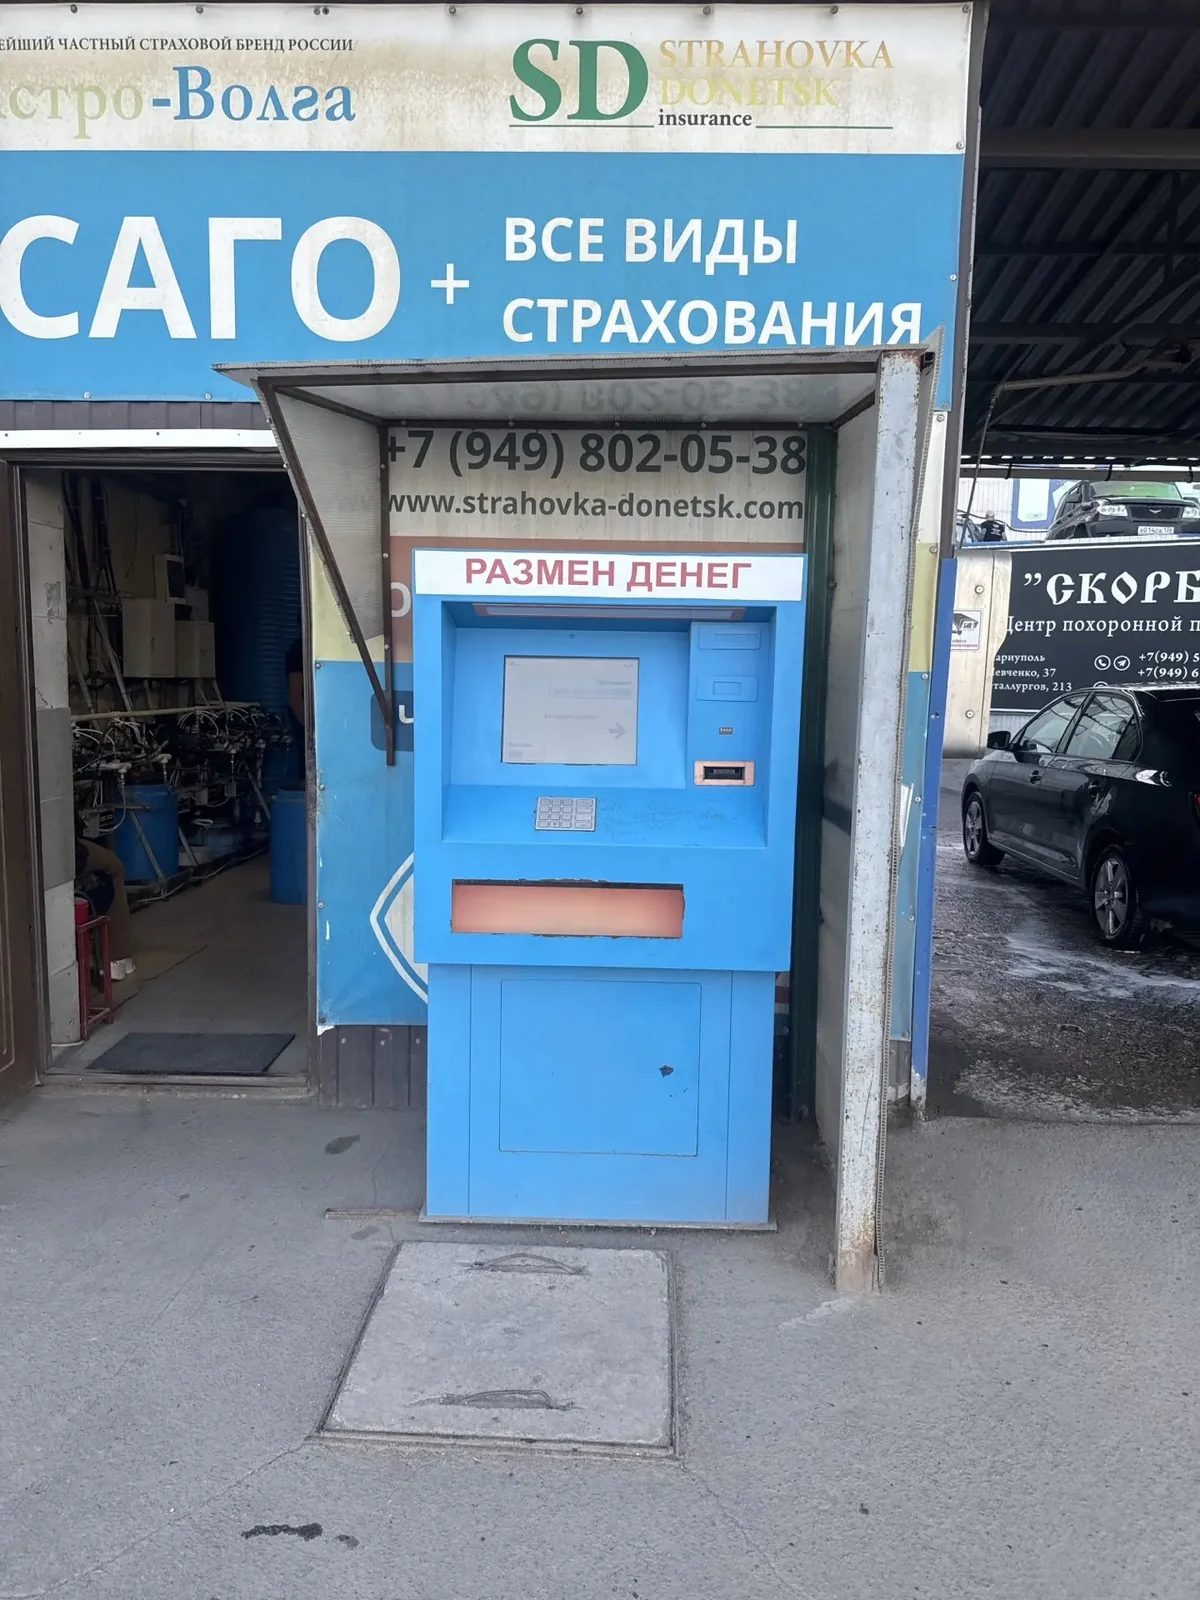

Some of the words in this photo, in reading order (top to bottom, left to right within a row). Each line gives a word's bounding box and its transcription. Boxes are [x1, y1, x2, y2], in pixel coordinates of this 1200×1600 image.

[0, 35, 55, 51] ЕЙШИЙ
[58, 35, 136, 52] ЧАСТНЫЙ
[139, 36, 233, 52] СТРАХОВОЙ
[235, 38, 285, 54] БРЕНД
[287, 38, 353, 52] РОССИИ
[659, 39, 895, 69] STRAHOVKA
[509, 38, 649, 122] SD
[660, 76, 838, 107] DONETSK
[0, 66, 356, 140] стро-Волга
[658, 108, 753, 127] insurance
[504, 217, 604, 263] ВСЕ
[625, 217, 798, 276] ВИДЫ
[0, 214, 401, 342] САГО
[503, 297, 923, 347] СТРАХОВАНИЯ
[388, 429, 435, 469] +7
[449, 430, 564, 480] (949)
[579, 432, 807, 476] 802-05-38
[388, 491, 804, 520] www.strahovka-donetsk.com
[465, 558, 615, 586] РАЗМЕН
[626, 562, 752, 592] ДЕНЕГ
[1063, 617, 1182, 637] похоронной
[995, 654, 1046, 664] ариуполь
[1139, 650, 1188, 664] +7(949)
[993, 668, 1040, 678] евченко,
[1042, 668, 1056, 677] 37
[993, 682, 1049, 692] таллургов,
[1052, 682, 1072, 691] 213
[1138, 666, 1187, 680] +7(949)
